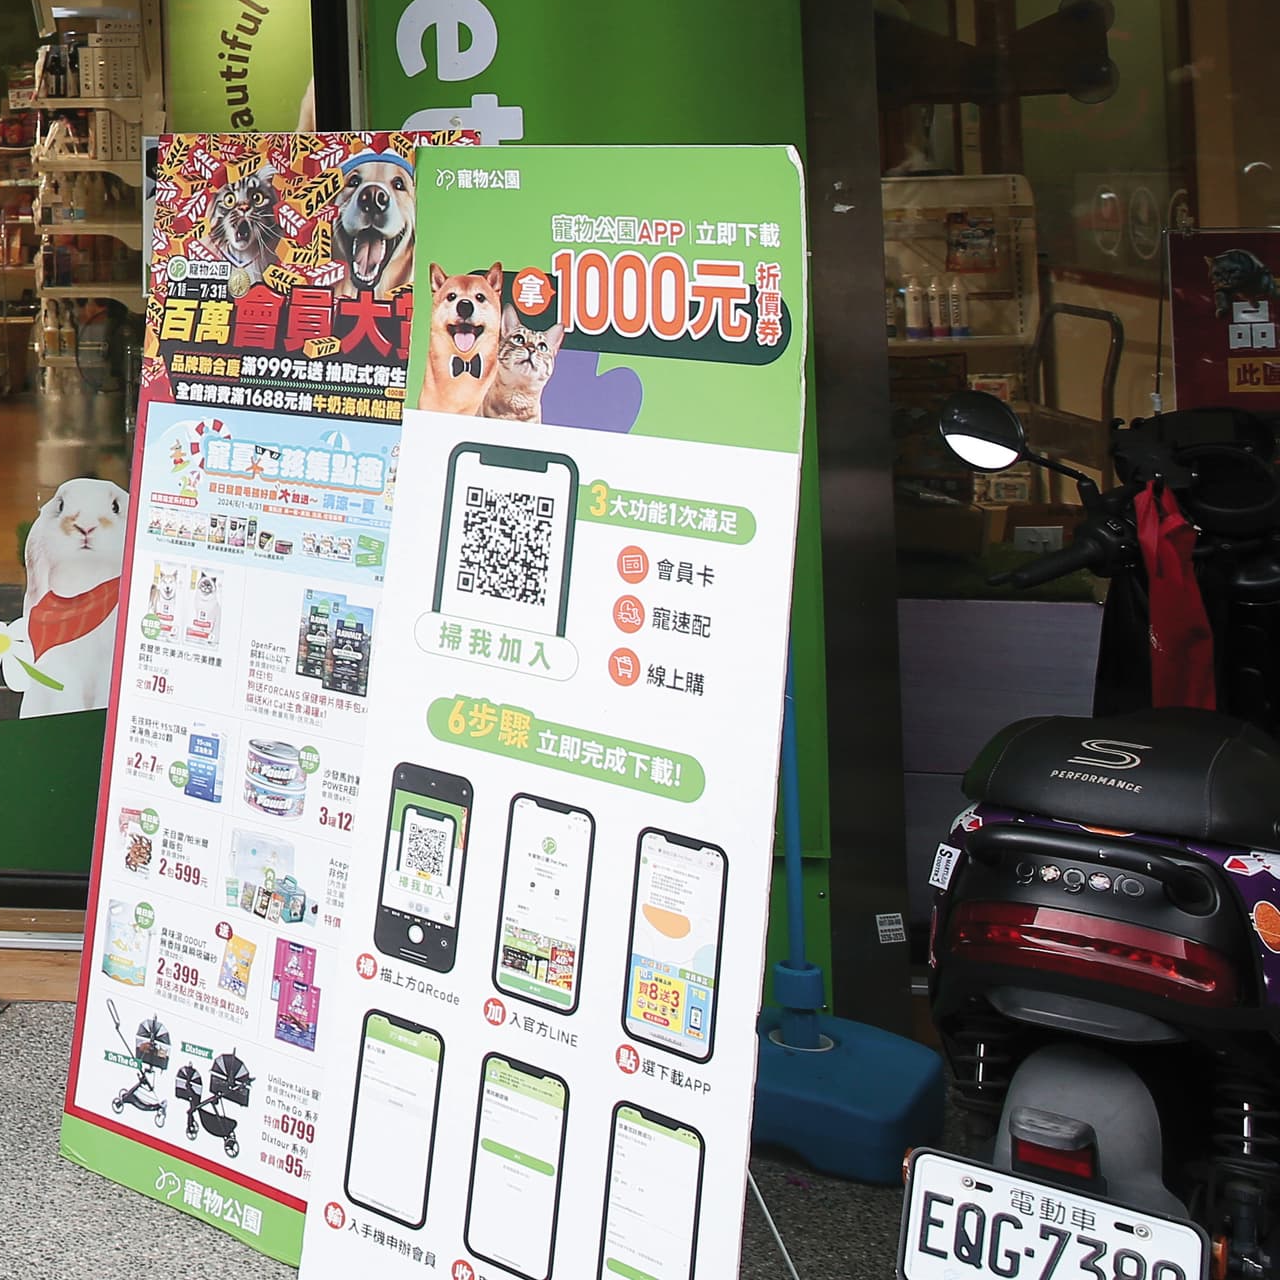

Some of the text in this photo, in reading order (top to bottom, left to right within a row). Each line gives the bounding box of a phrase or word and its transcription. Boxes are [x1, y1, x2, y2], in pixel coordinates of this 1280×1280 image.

[456, 170, 521, 190] 寵物公園
[552, 214, 782, 249] 寵物公園APP 立即下載
[189, 263, 230, 277] 寵物公園
[516, 249, 783, 347] 拿 1000元 折價券
[589, 483, 739, 536] 3大功能1次滿足
[656, 557, 715, 589] 會員卡
[651, 607, 712, 640] 寵速配
[438, 619, 551, 671] 掃我加入
[646, 664, 705, 697] 線上購
[447, 699, 682, 787] 6步驟 立即完成下載!
[321, 780, 360, 798] POWER超
[1048, 768, 1144, 795] PERFORMANCE
[319, 805, 356, 833] 3罐12
[1015, 862, 1145, 899] ggro
[183, 1179, 264, 1236] 寵物公園
[1008, 1187, 1097, 1233] 電動車
